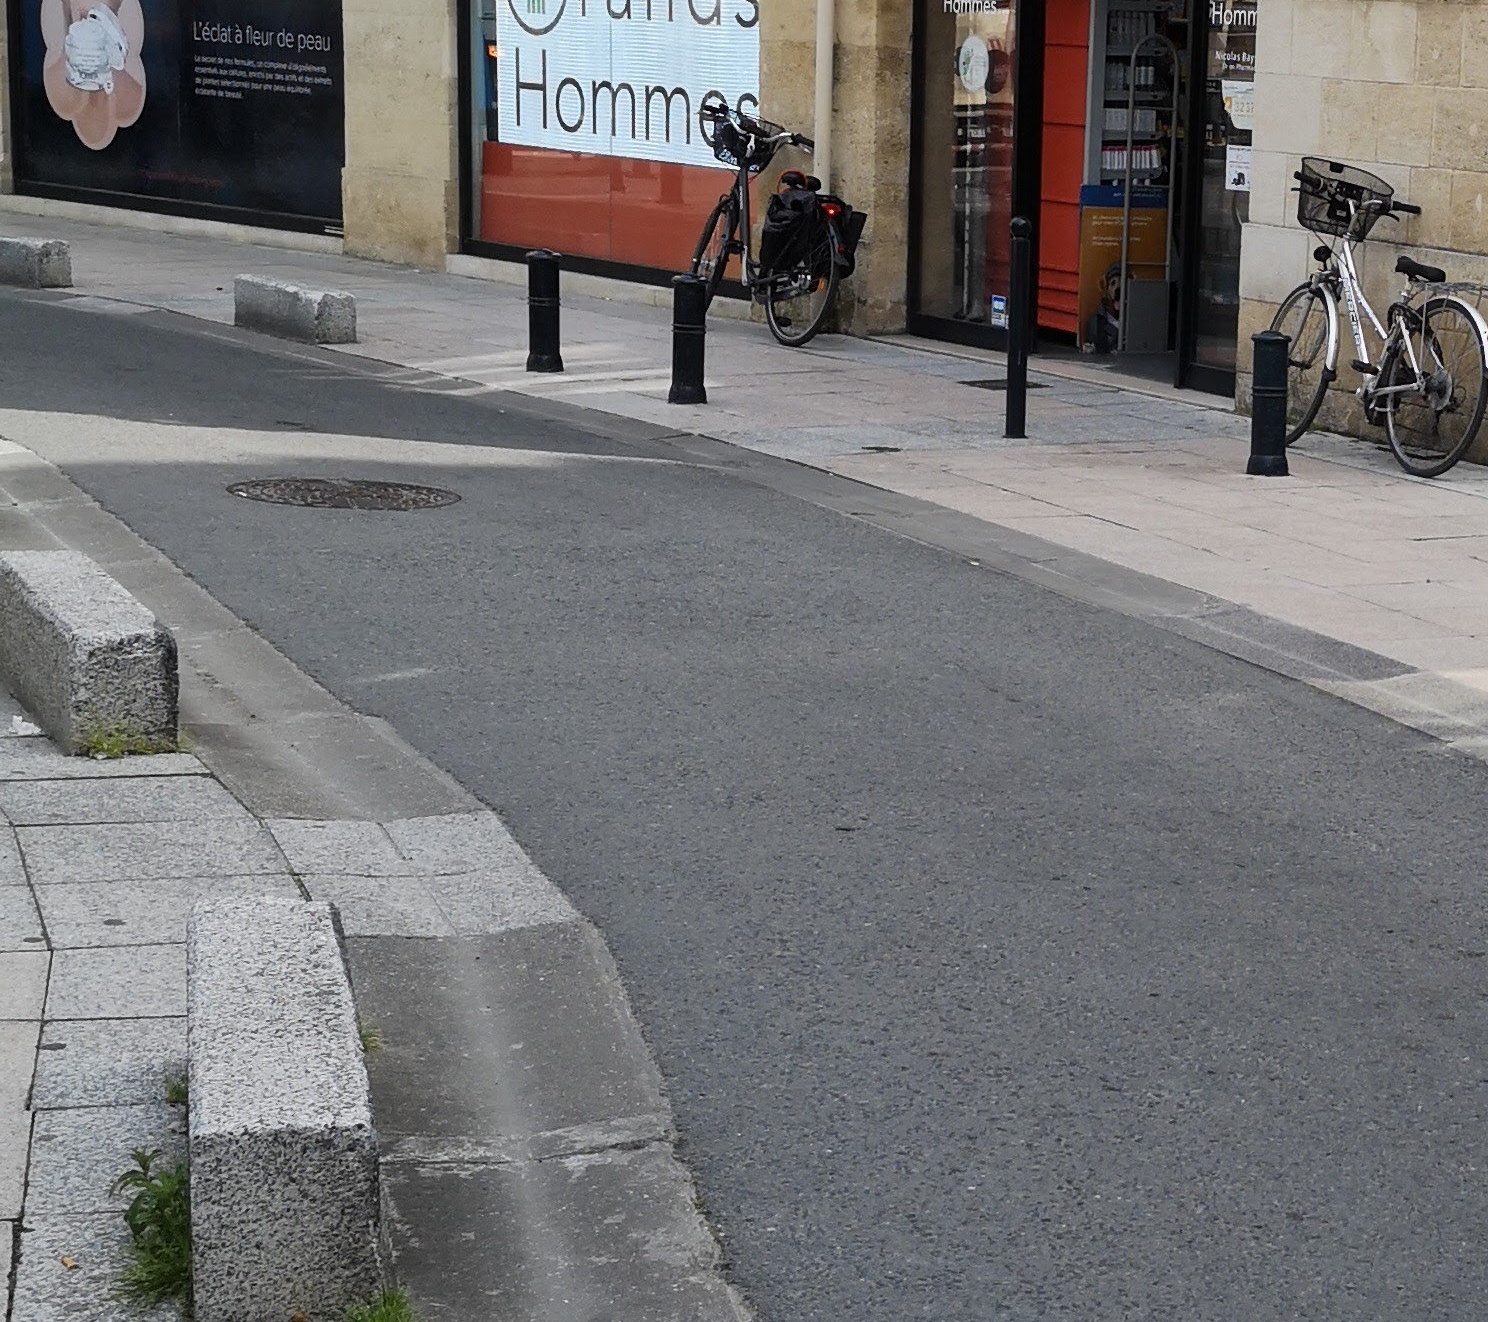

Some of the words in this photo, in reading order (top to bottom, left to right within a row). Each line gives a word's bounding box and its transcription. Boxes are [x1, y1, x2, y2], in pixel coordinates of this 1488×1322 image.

[193, 20, 233, 44] L'éclat
[234, 23, 243, 45] à
[245, 24, 275, 47] fleur
[276, 27, 295, 49] de
[297, 32, 331, 53] peau
[1215, 50, 1241, 62] Nicolas
